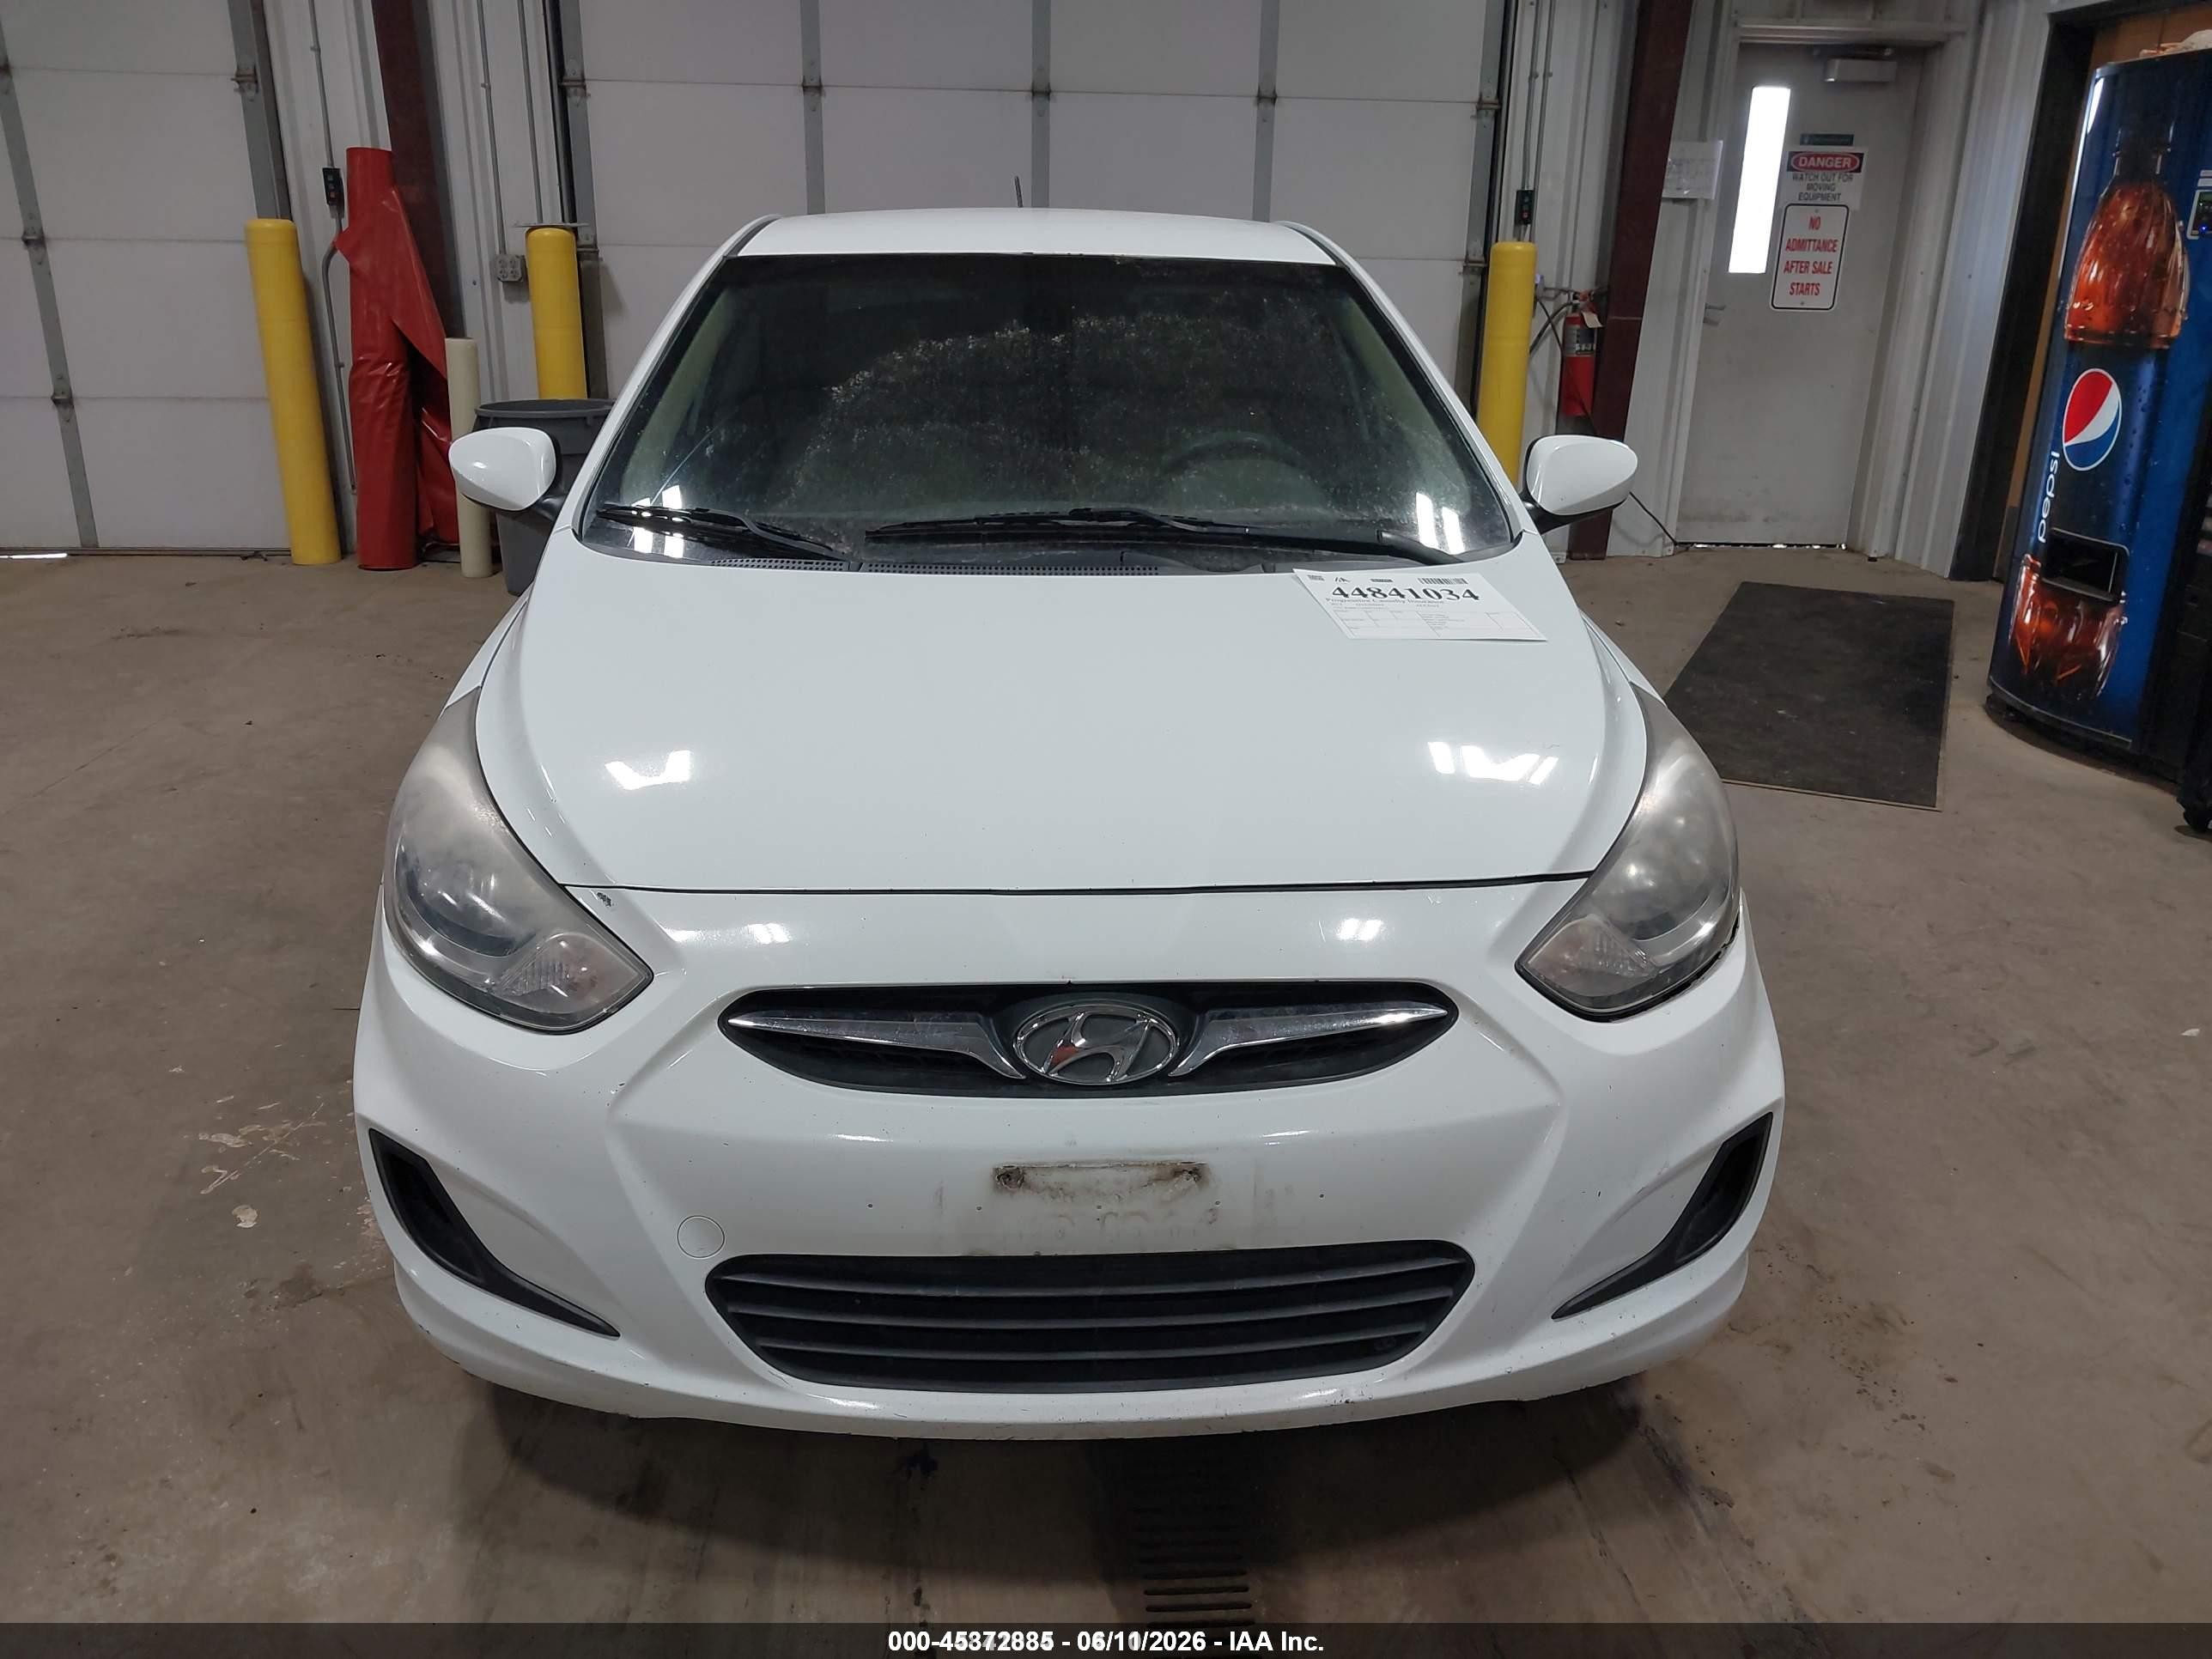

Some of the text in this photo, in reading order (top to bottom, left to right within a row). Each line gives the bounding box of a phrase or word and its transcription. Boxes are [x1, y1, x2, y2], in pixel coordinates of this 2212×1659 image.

[1799, 156, 1851, 168] DANGER
[1792, 173, 1853, 183] WATCH OUT FOR
[1806, 183, 1836, 192] MOVING
[1798, 191, 1842, 201] EQUIPMENT
[1808, 216, 1821, 230] NO
[1785, 239, 1838, 252] ADMITTANCE
[1784, 260, 1833, 274] AFTER SALE
[1790, 282, 1820, 296] STARTS
[2038, 450, 2061, 544] pepsi
[1332, 586, 1480, 601] 44841034
